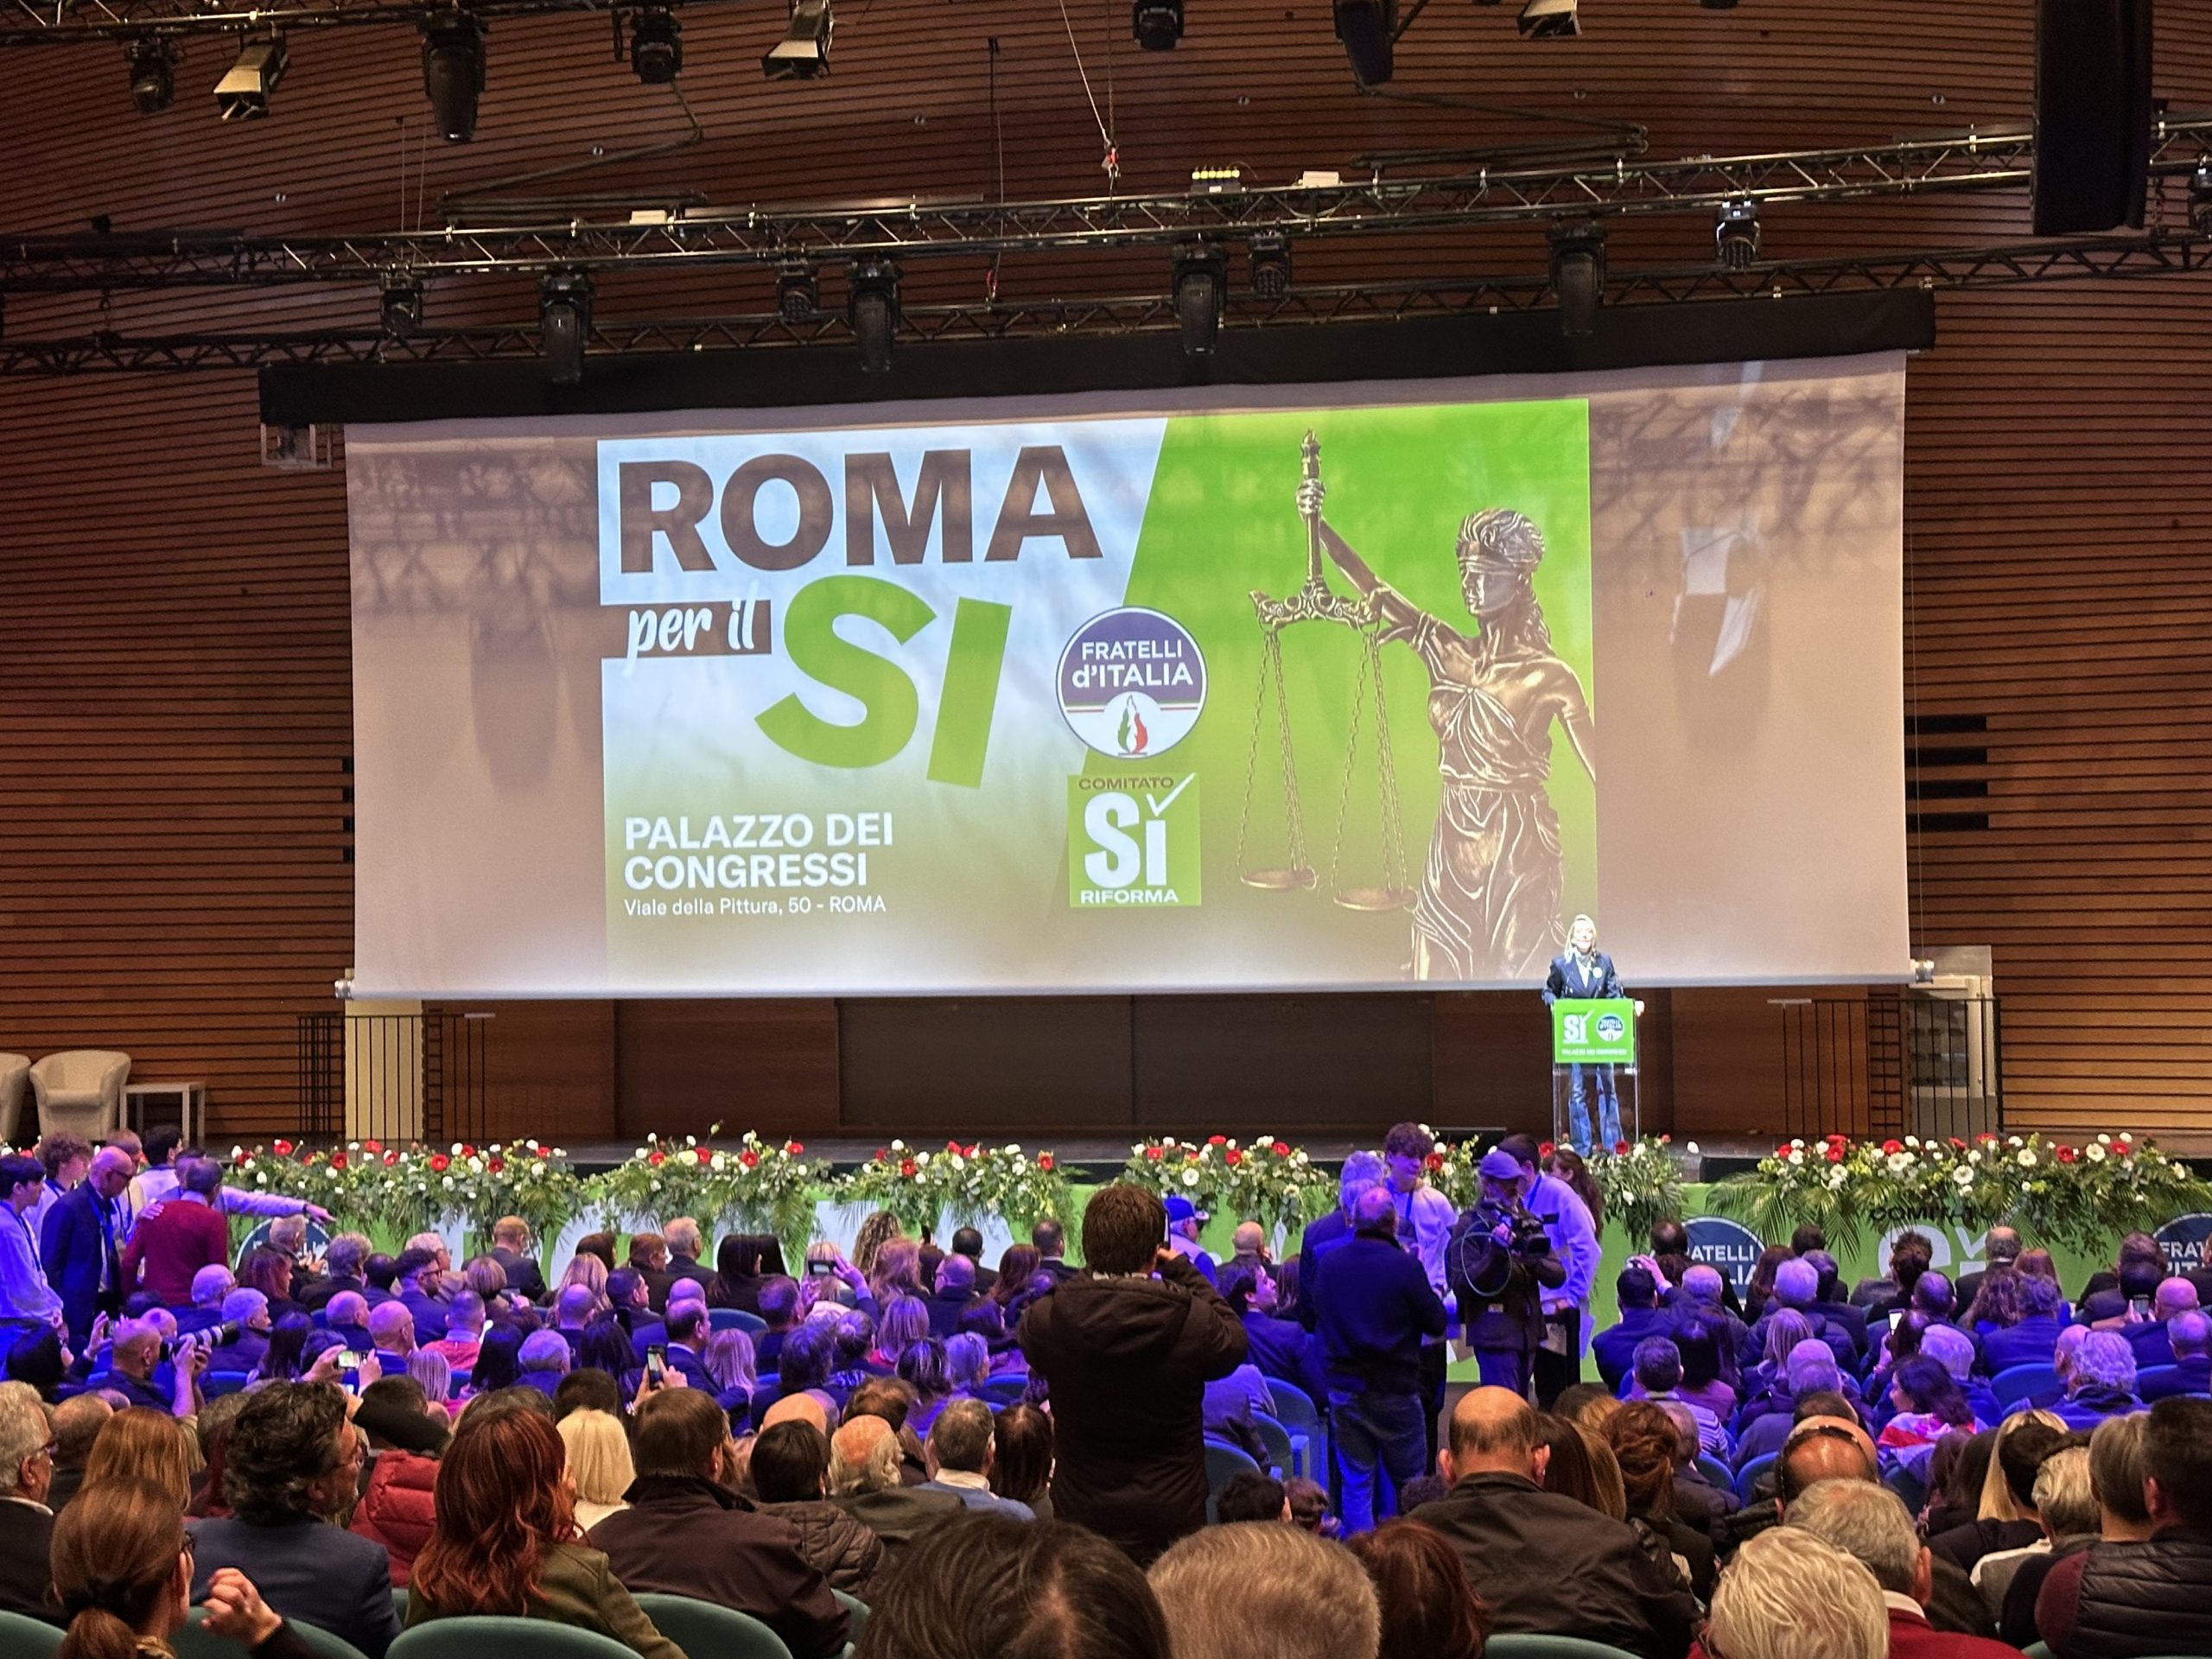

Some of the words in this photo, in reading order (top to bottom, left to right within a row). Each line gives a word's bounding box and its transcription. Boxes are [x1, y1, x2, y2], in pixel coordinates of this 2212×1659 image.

[619, 445, 1103, 574] ROMA
[621, 607, 713, 677] per
[728, 579, 760, 650] il
[1082, 639, 1182, 660] FRATELLI
[1071, 662, 1193, 688] d'ITALIA
[1078, 777, 1174, 791] COMITATO
[625, 813, 814, 850] PALAZZO
[826, 811, 893, 848] DEI
[624, 852, 868, 891] CONGRESSI
[624, 899, 667, 917] Viale
[672, 897, 714, 916] della
[720, 896, 783, 917] Pittura,
[788, 897, 811, 913] 50
[830, 895, 887, 913] ROMA
[1080, 889, 1179, 905] RIFORMA
[1686, 1244, 1755, 1262] ATELLI
